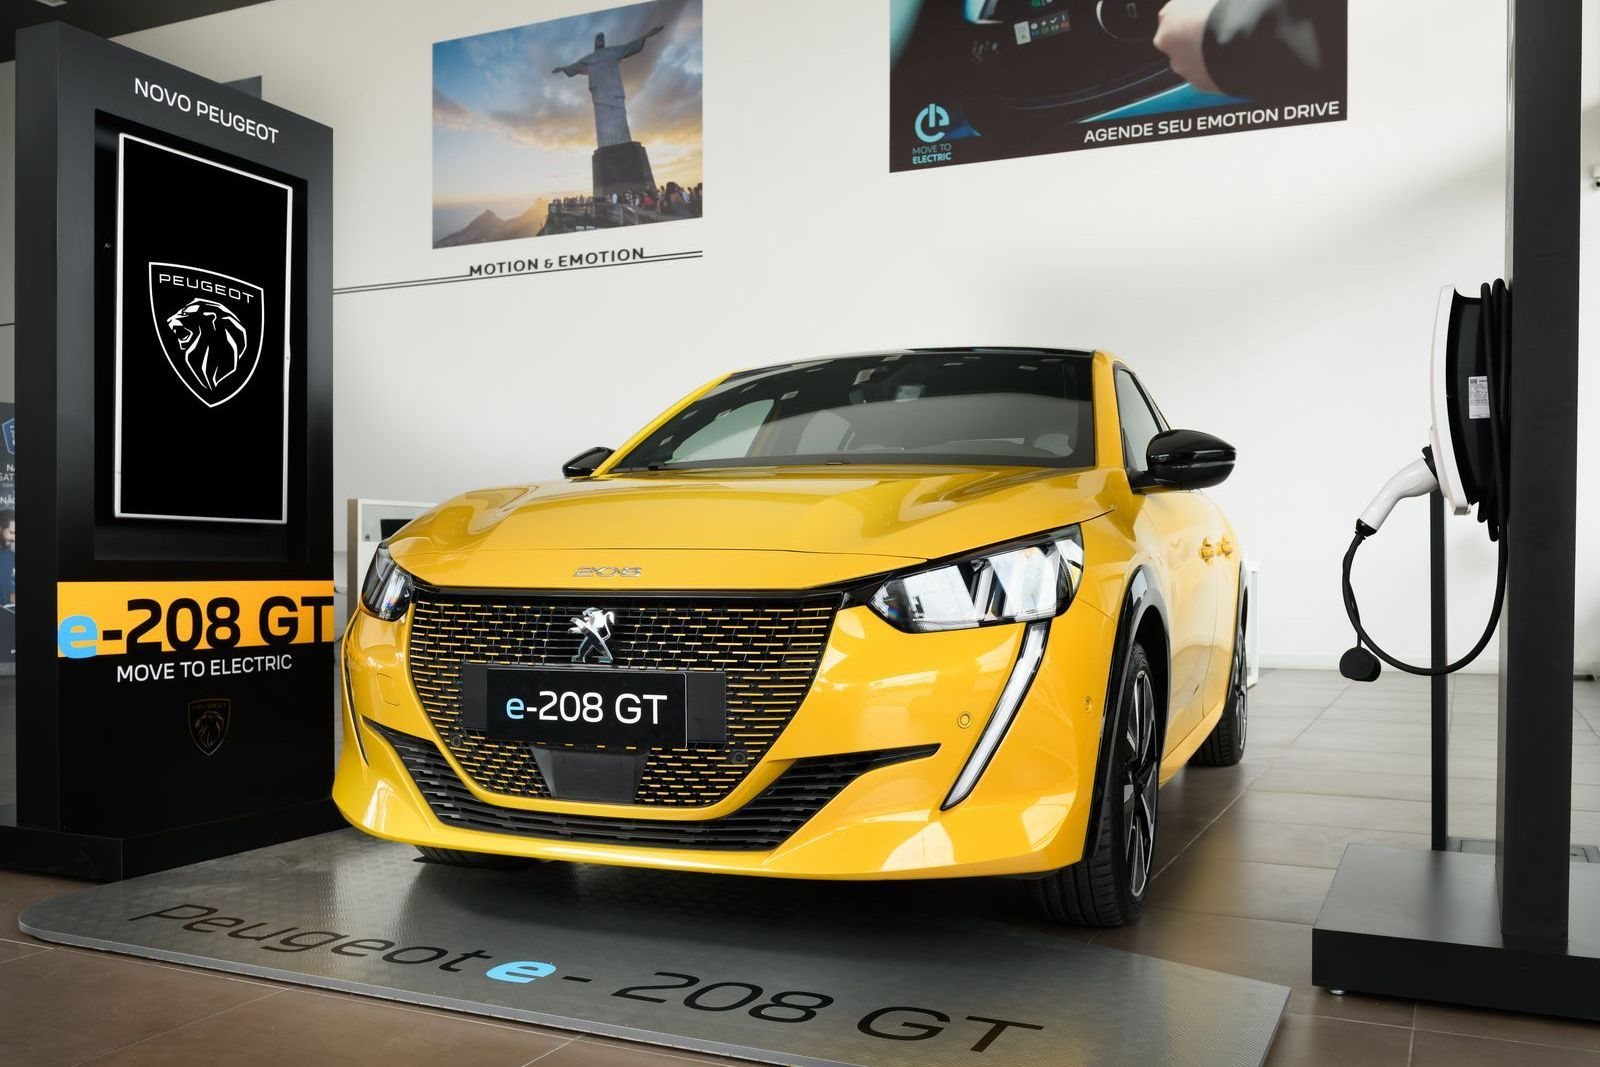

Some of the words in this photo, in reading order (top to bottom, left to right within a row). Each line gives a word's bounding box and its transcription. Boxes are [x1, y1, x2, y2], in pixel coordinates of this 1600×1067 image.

[134, 77, 191, 112] NOVO
[196, 100, 279, 144] PEUGEOT
[1083, 122, 1154, 144] AGENDE
[1158, 118, 1192, 135] SEU
[1197, 108, 1279, 132] EMOTION
[1283, 100, 1340, 121] DRIVE
[912, 144, 938, 155] MOVE
[939, 142, 952, 152] TO
[912, 151, 952, 165] ELECTRIC
[469, 258, 539, 276] MOTION
[544, 257, 554, 269] &
[558, 247, 645, 268] EMOTION
[159, 273, 254, 304] PEUGEOT
[57, 597, 241, 659] e-208
[258, 595, 334, 647] GT
[116, 662, 175, 683] MOVE
[180, 660, 206, 679] TO
[210, 654, 293, 676] ELECTRIC
[505, 690, 604, 724] e-208
[614, 693, 668, 725] GT
[127, 903, 493, 973] Peugeot
[857, 1005, 1045, 1053] GT
